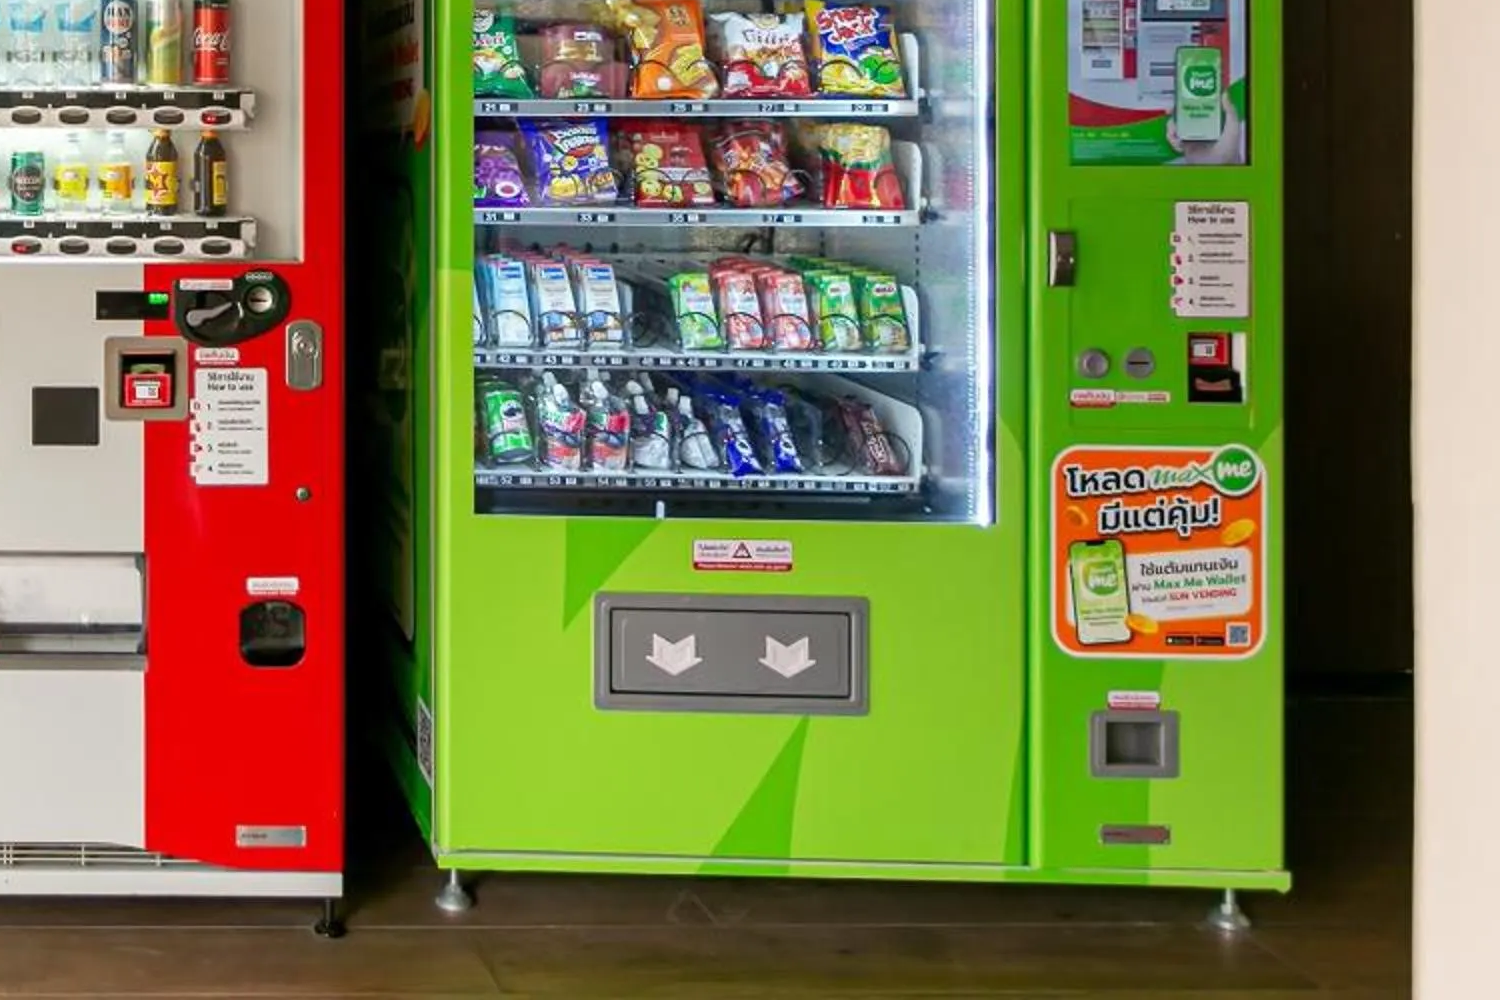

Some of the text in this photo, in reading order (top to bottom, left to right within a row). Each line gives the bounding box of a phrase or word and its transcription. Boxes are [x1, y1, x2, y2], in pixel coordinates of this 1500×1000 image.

[207, 383, 226, 391] How
[228, 383, 237, 391] to
[1066, 459, 1251, 493] โหลด max me
[1100, 497, 1219, 534] มีแต่คุ้ม!
[1153, 579, 1181, 590] Max
[1183, 577, 1203, 587] Me
[1206, 573, 1246, 585] Wallet
